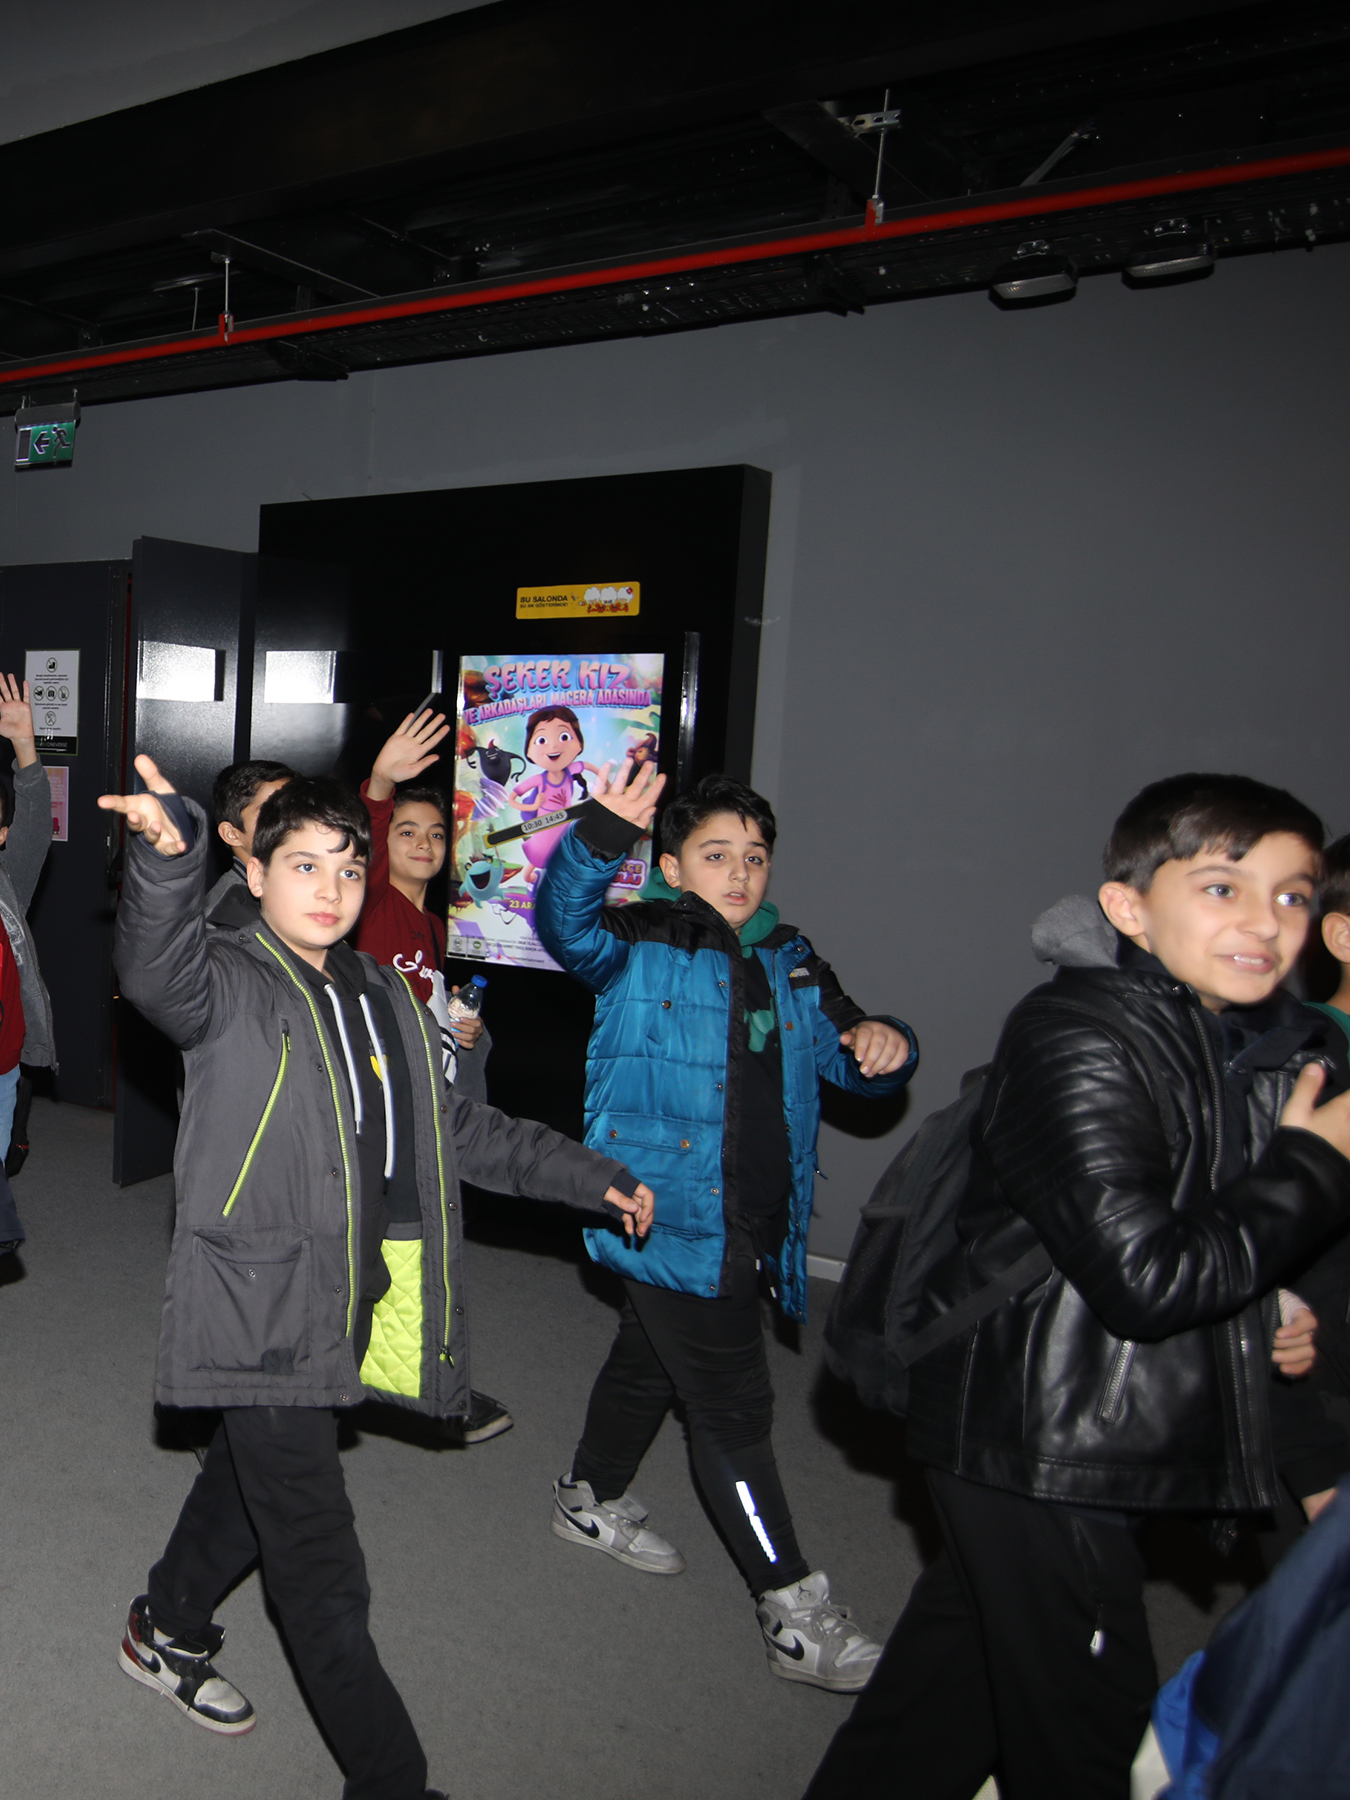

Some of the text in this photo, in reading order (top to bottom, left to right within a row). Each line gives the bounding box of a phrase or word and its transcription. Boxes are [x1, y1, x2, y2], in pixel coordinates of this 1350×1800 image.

[484, 660, 630, 699] ŞEKER KIZ
[463, 688, 651, 724] VE ARKADAŞLARI MACERA ADASINDA
[523, 811, 564, 831] 10:30 14:45
[509, 900, 536, 910] 23 ARA
